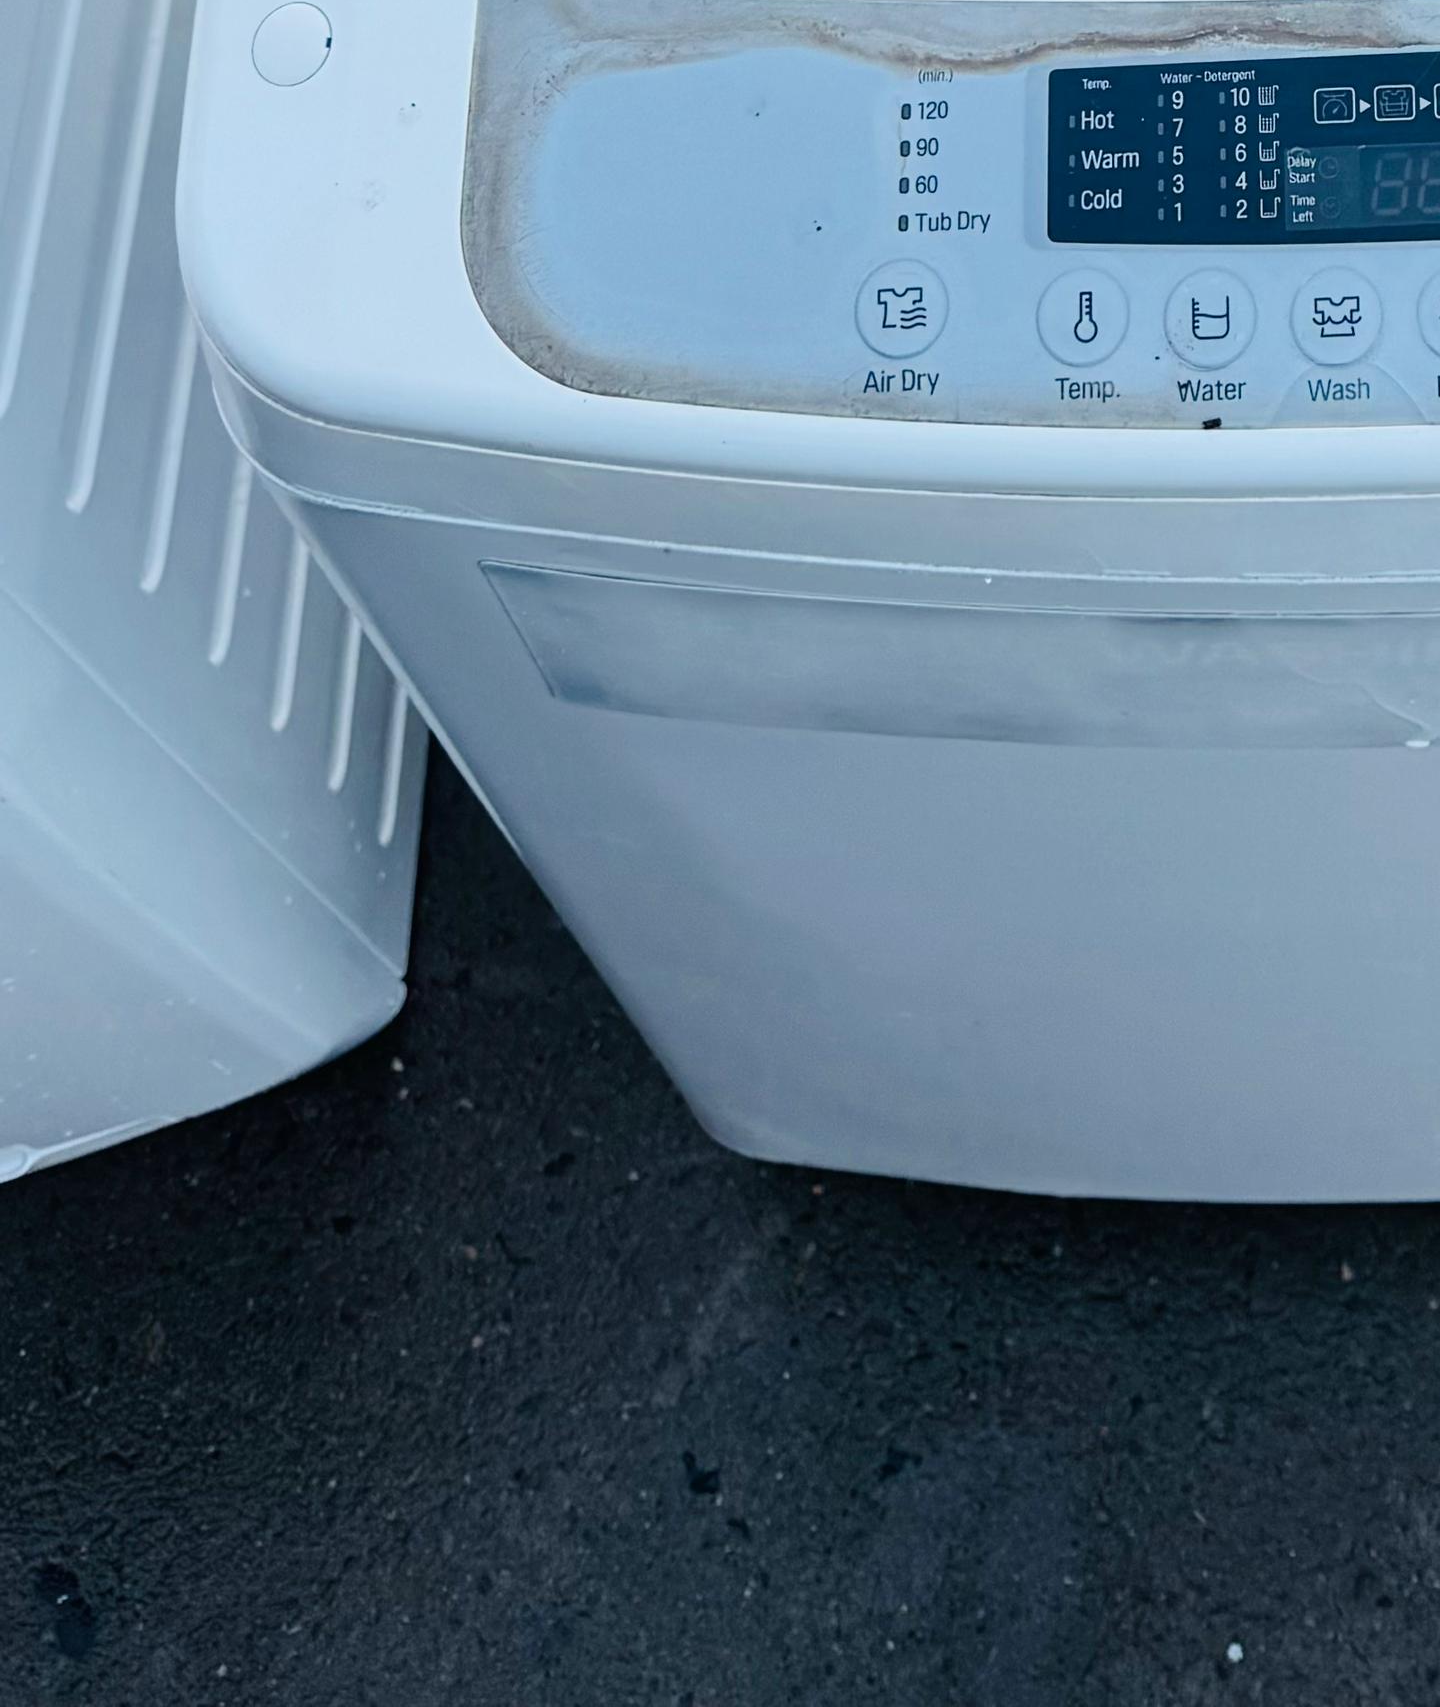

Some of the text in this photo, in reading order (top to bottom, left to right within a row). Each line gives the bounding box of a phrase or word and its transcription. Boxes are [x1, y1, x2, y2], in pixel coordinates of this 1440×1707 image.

[1082, 78, 1112, 90] Temp.
[1160, 73, 1193, 84] Water
[1172, 87, 1251, 110] 9 10
[918, 101, 948, 120] 120
[1081, 111, 1115, 131] Hot
[1173, 115, 1247, 138] 7 8
[916, 138, 939, 156] 90
[1172, 143, 1247, 166] 5 6
[1082, 150, 1140, 169] Warm
[915, 175, 938, 194] 60
[1172, 171, 1248, 193] 3 4
[1289, 172, 1315, 183] Start
[1081, 189, 1123, 210] Cold
[1290, 195, 1315, 206] Time
[1174, 200, 1248, 222] 1 2
[1293, 211, 1313, 223] Left
[915, 211, 991, 233] Tub Dry
[863, 369, 940, 396] Air Dry
[1055, 379, 1120, 401] Temp.
[1177, 379, 1247, 401] Water
[1308, 379, 1371, 401] Wash
